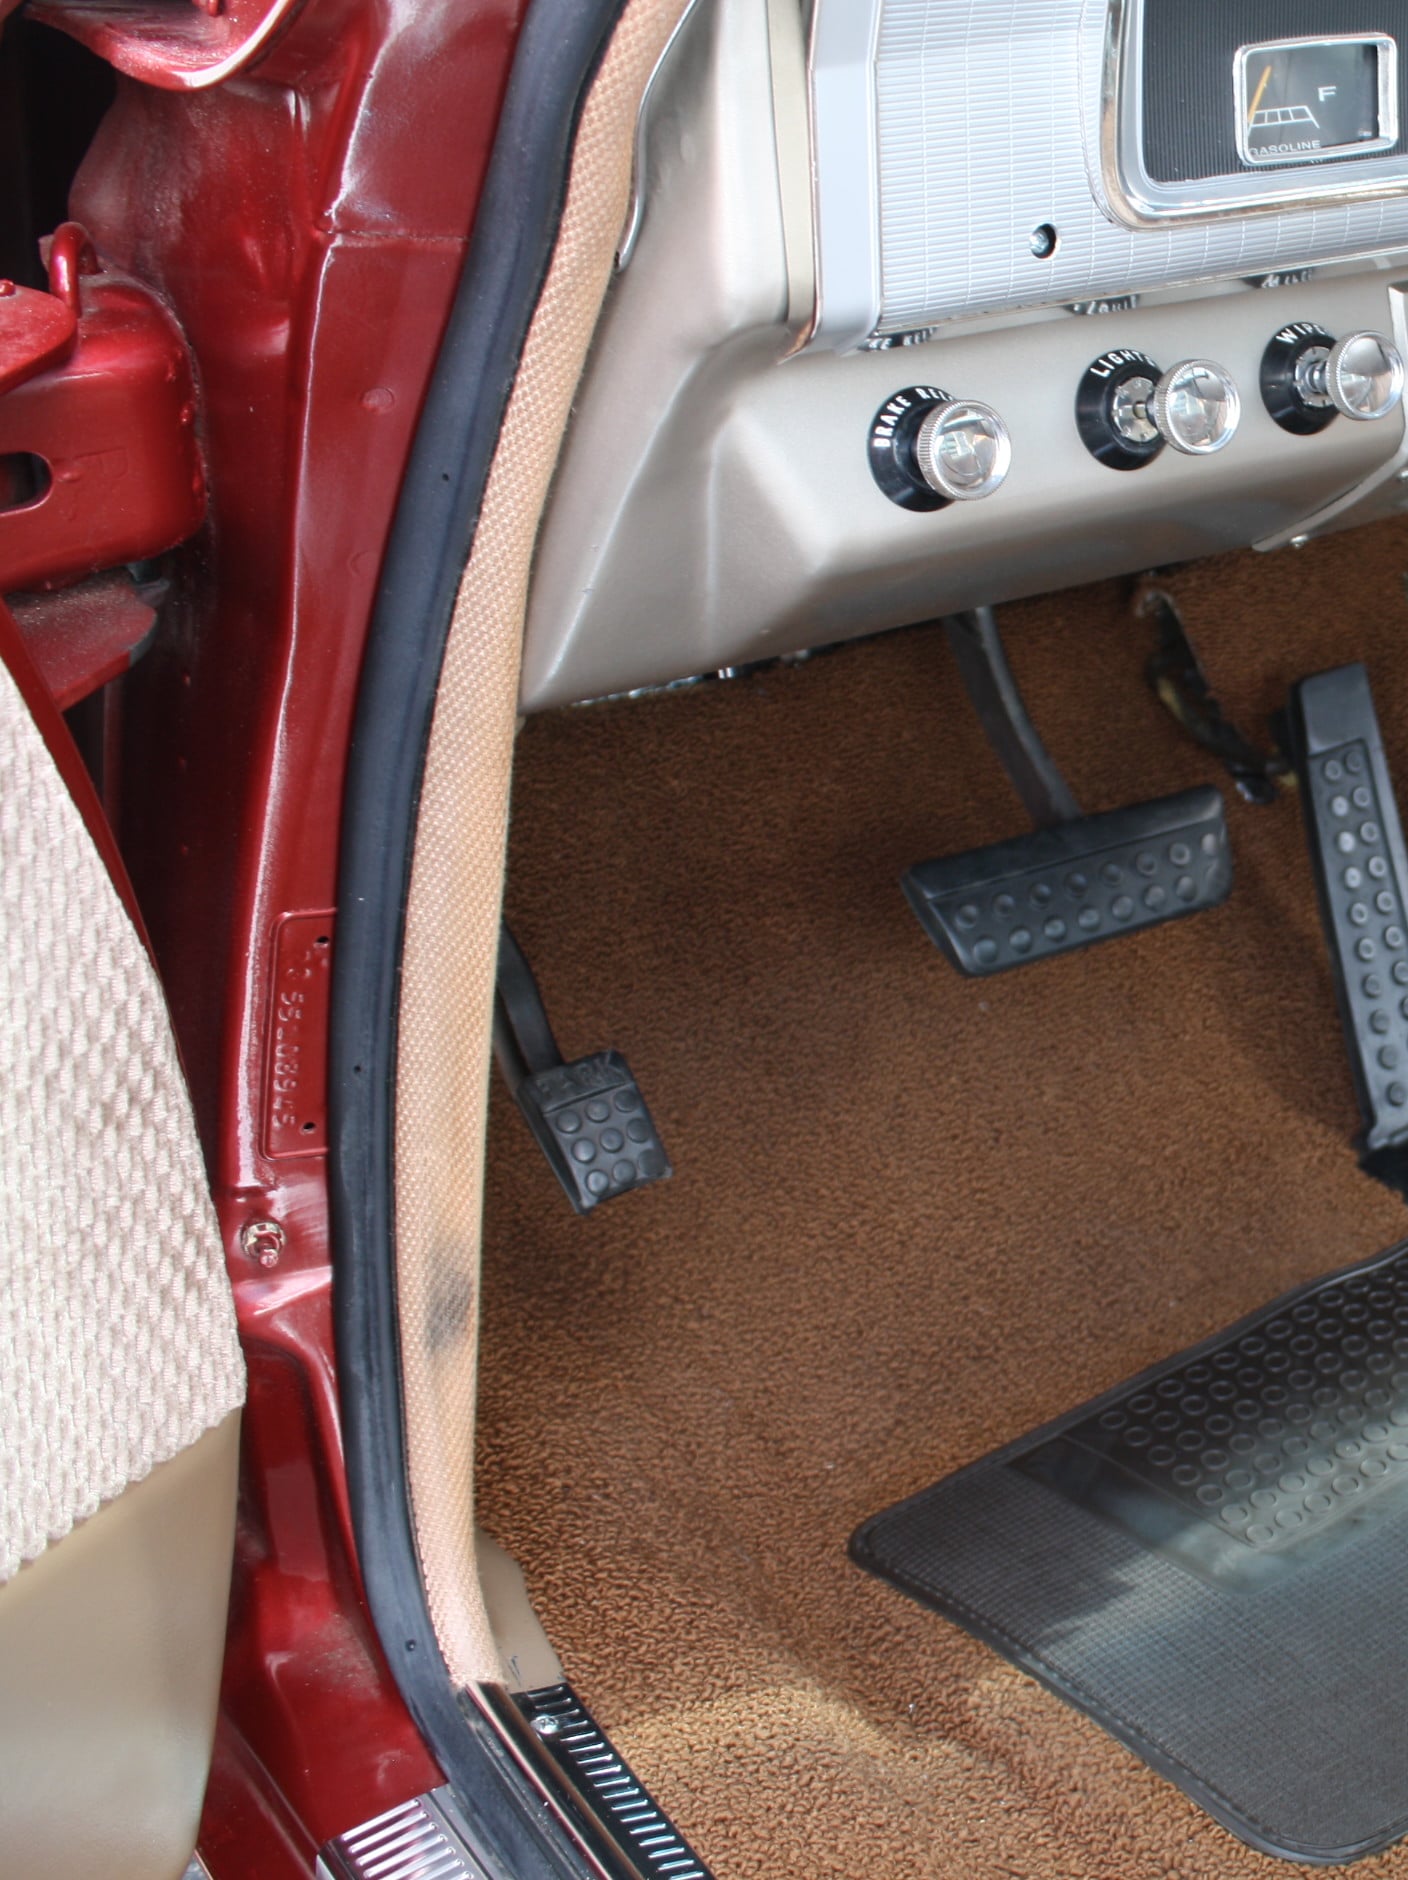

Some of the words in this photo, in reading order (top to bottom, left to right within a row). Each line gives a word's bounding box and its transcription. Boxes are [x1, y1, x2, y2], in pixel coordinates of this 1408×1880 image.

[1316, 84, 1338, 102] F
[1249, 139, 1321, 157] GASOLINE
[873, 395, 912, 448] BRAKE
